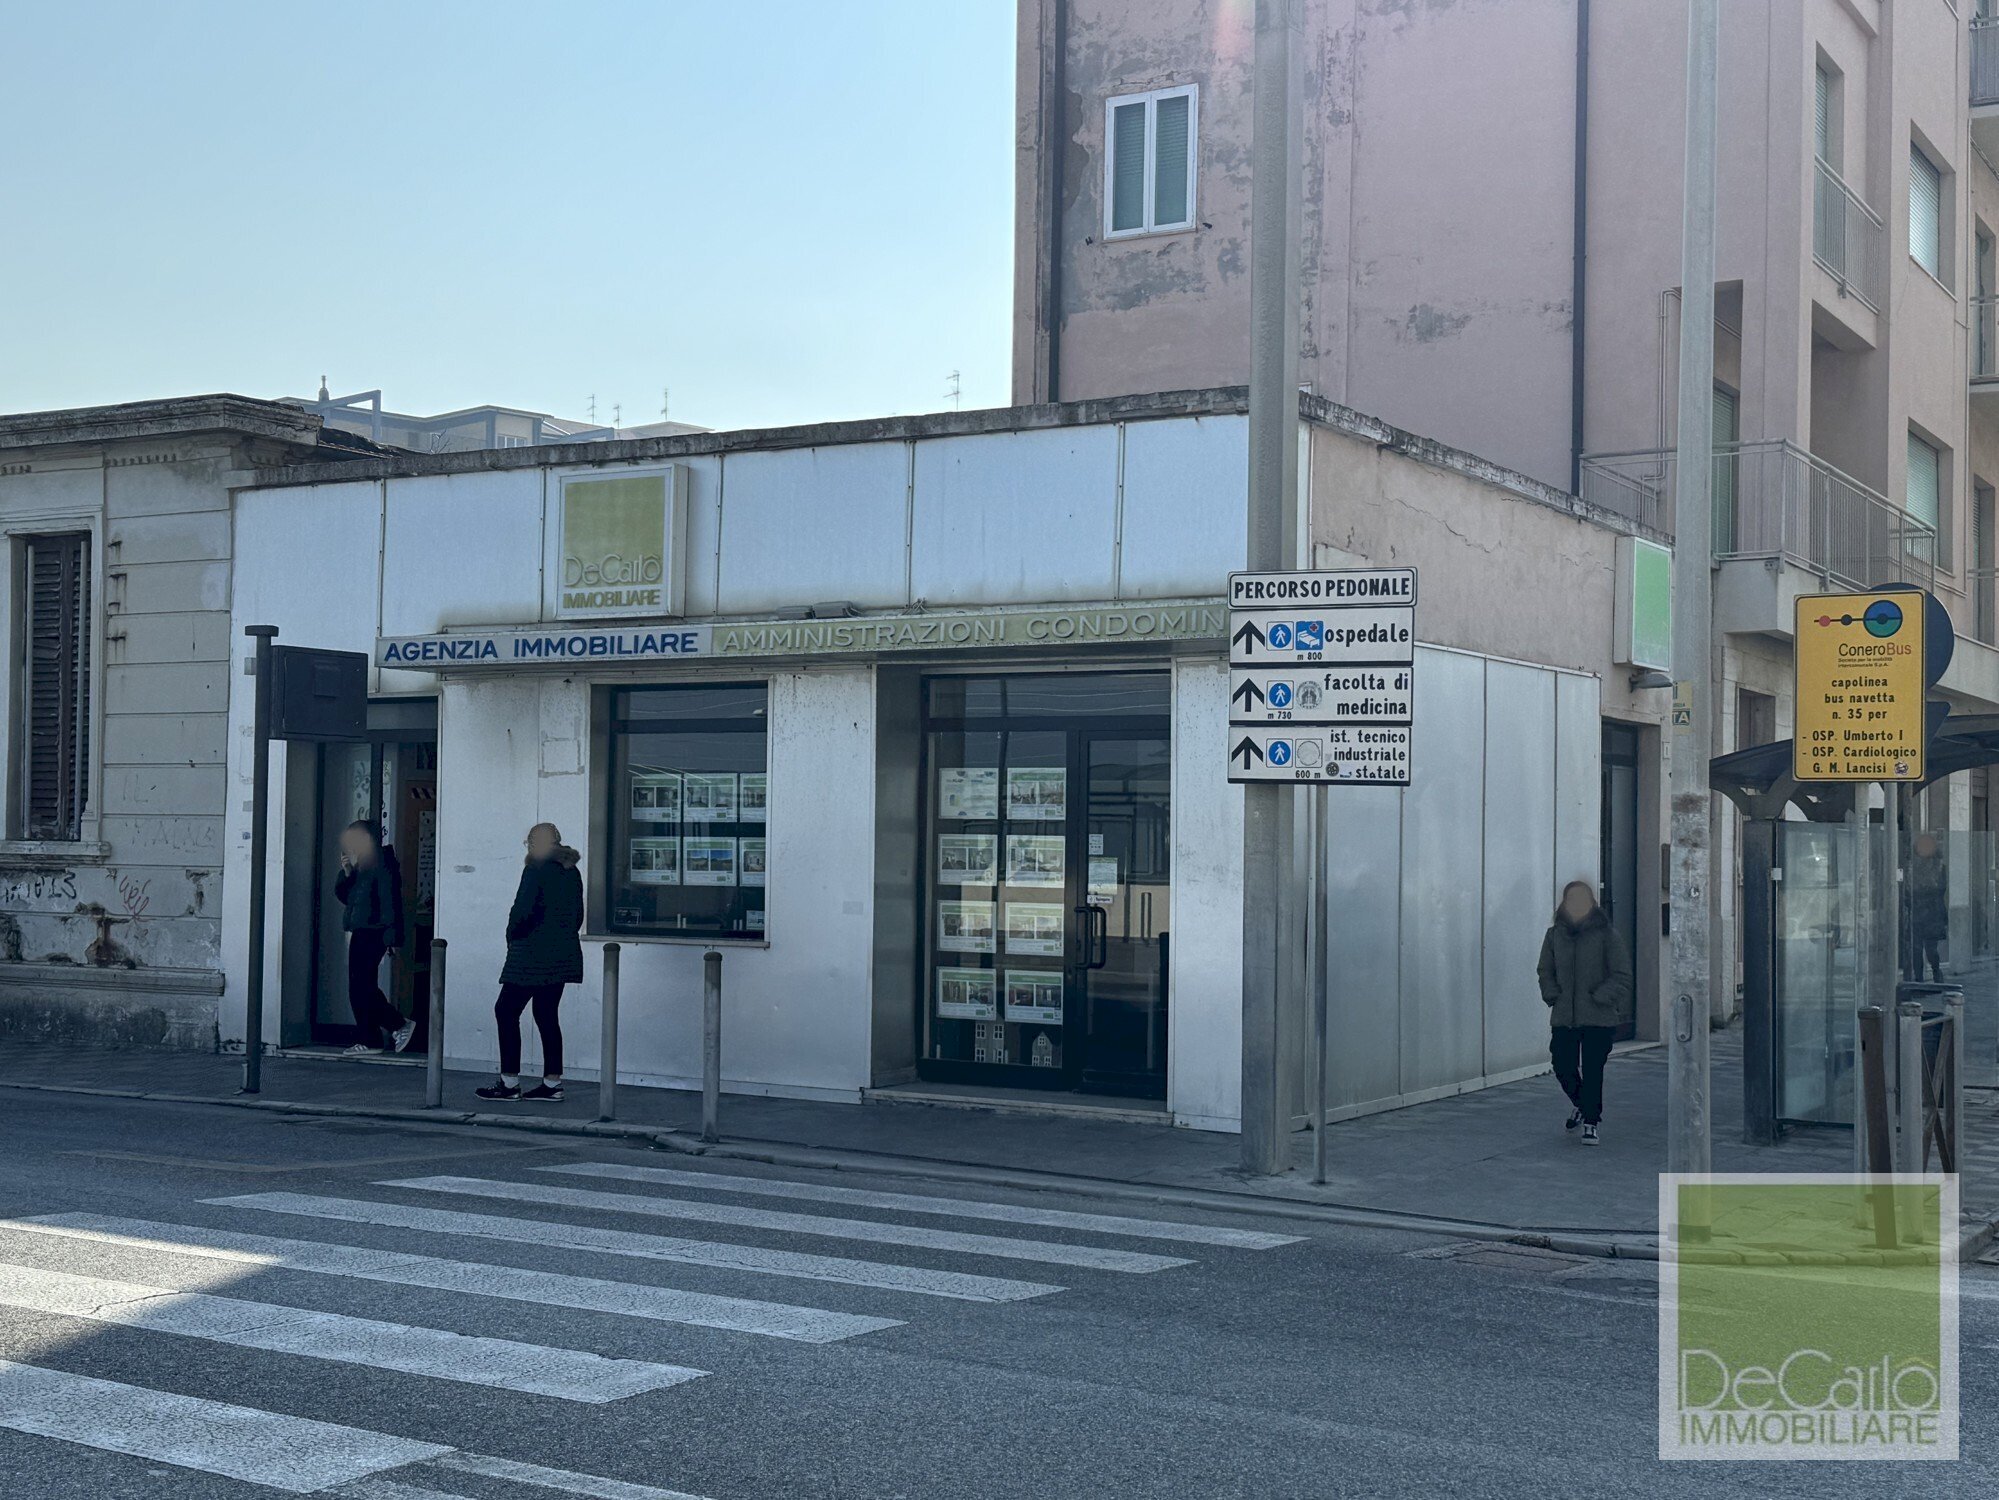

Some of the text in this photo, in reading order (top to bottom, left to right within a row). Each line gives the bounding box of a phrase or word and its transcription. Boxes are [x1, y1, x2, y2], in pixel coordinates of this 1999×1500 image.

[1234, 577, 1410, 599] PERCORSO PEDONALE
[563, 588, 661, 609] IMMOBILIARE
[721, 607, 1225, 652] AMMINISTRAZIONI CONDOMIN
[1324, 623, 1410, 647] ospedale
[384, 632, 699, 662] AGENZIA IMMOBILIARE
[1838, 642, 1912, 656] ConeroBus
[1307, 652, 1322, 661] 800
[1394, 672, 1409, 690] di
[1831, 676, 1888, 689] capolinea
[1824, 692, 1895, 703] bus navetta
[1336, 697, 1407, 715] medicina
[1277, 711, 1292, 720] 730
[1832, 709, 1887, 721] n. 35 per
[1330, 729, 1406, 743] ist. tecnico
[1812, 730, 1838, 741] OSP.
[1843, 729, 1893, 741] Umberto
[1334, 747, 1406, 761] industriale
[1812, 747, 1838, 757] OSP.
[1843, 746, 1917, 759] Cardiologico
[1295, 770, 1310, 779] 600
[1355, 765, 1406, 779] statale
[1813, 762, 1887, 774] G. M. Lancisi
